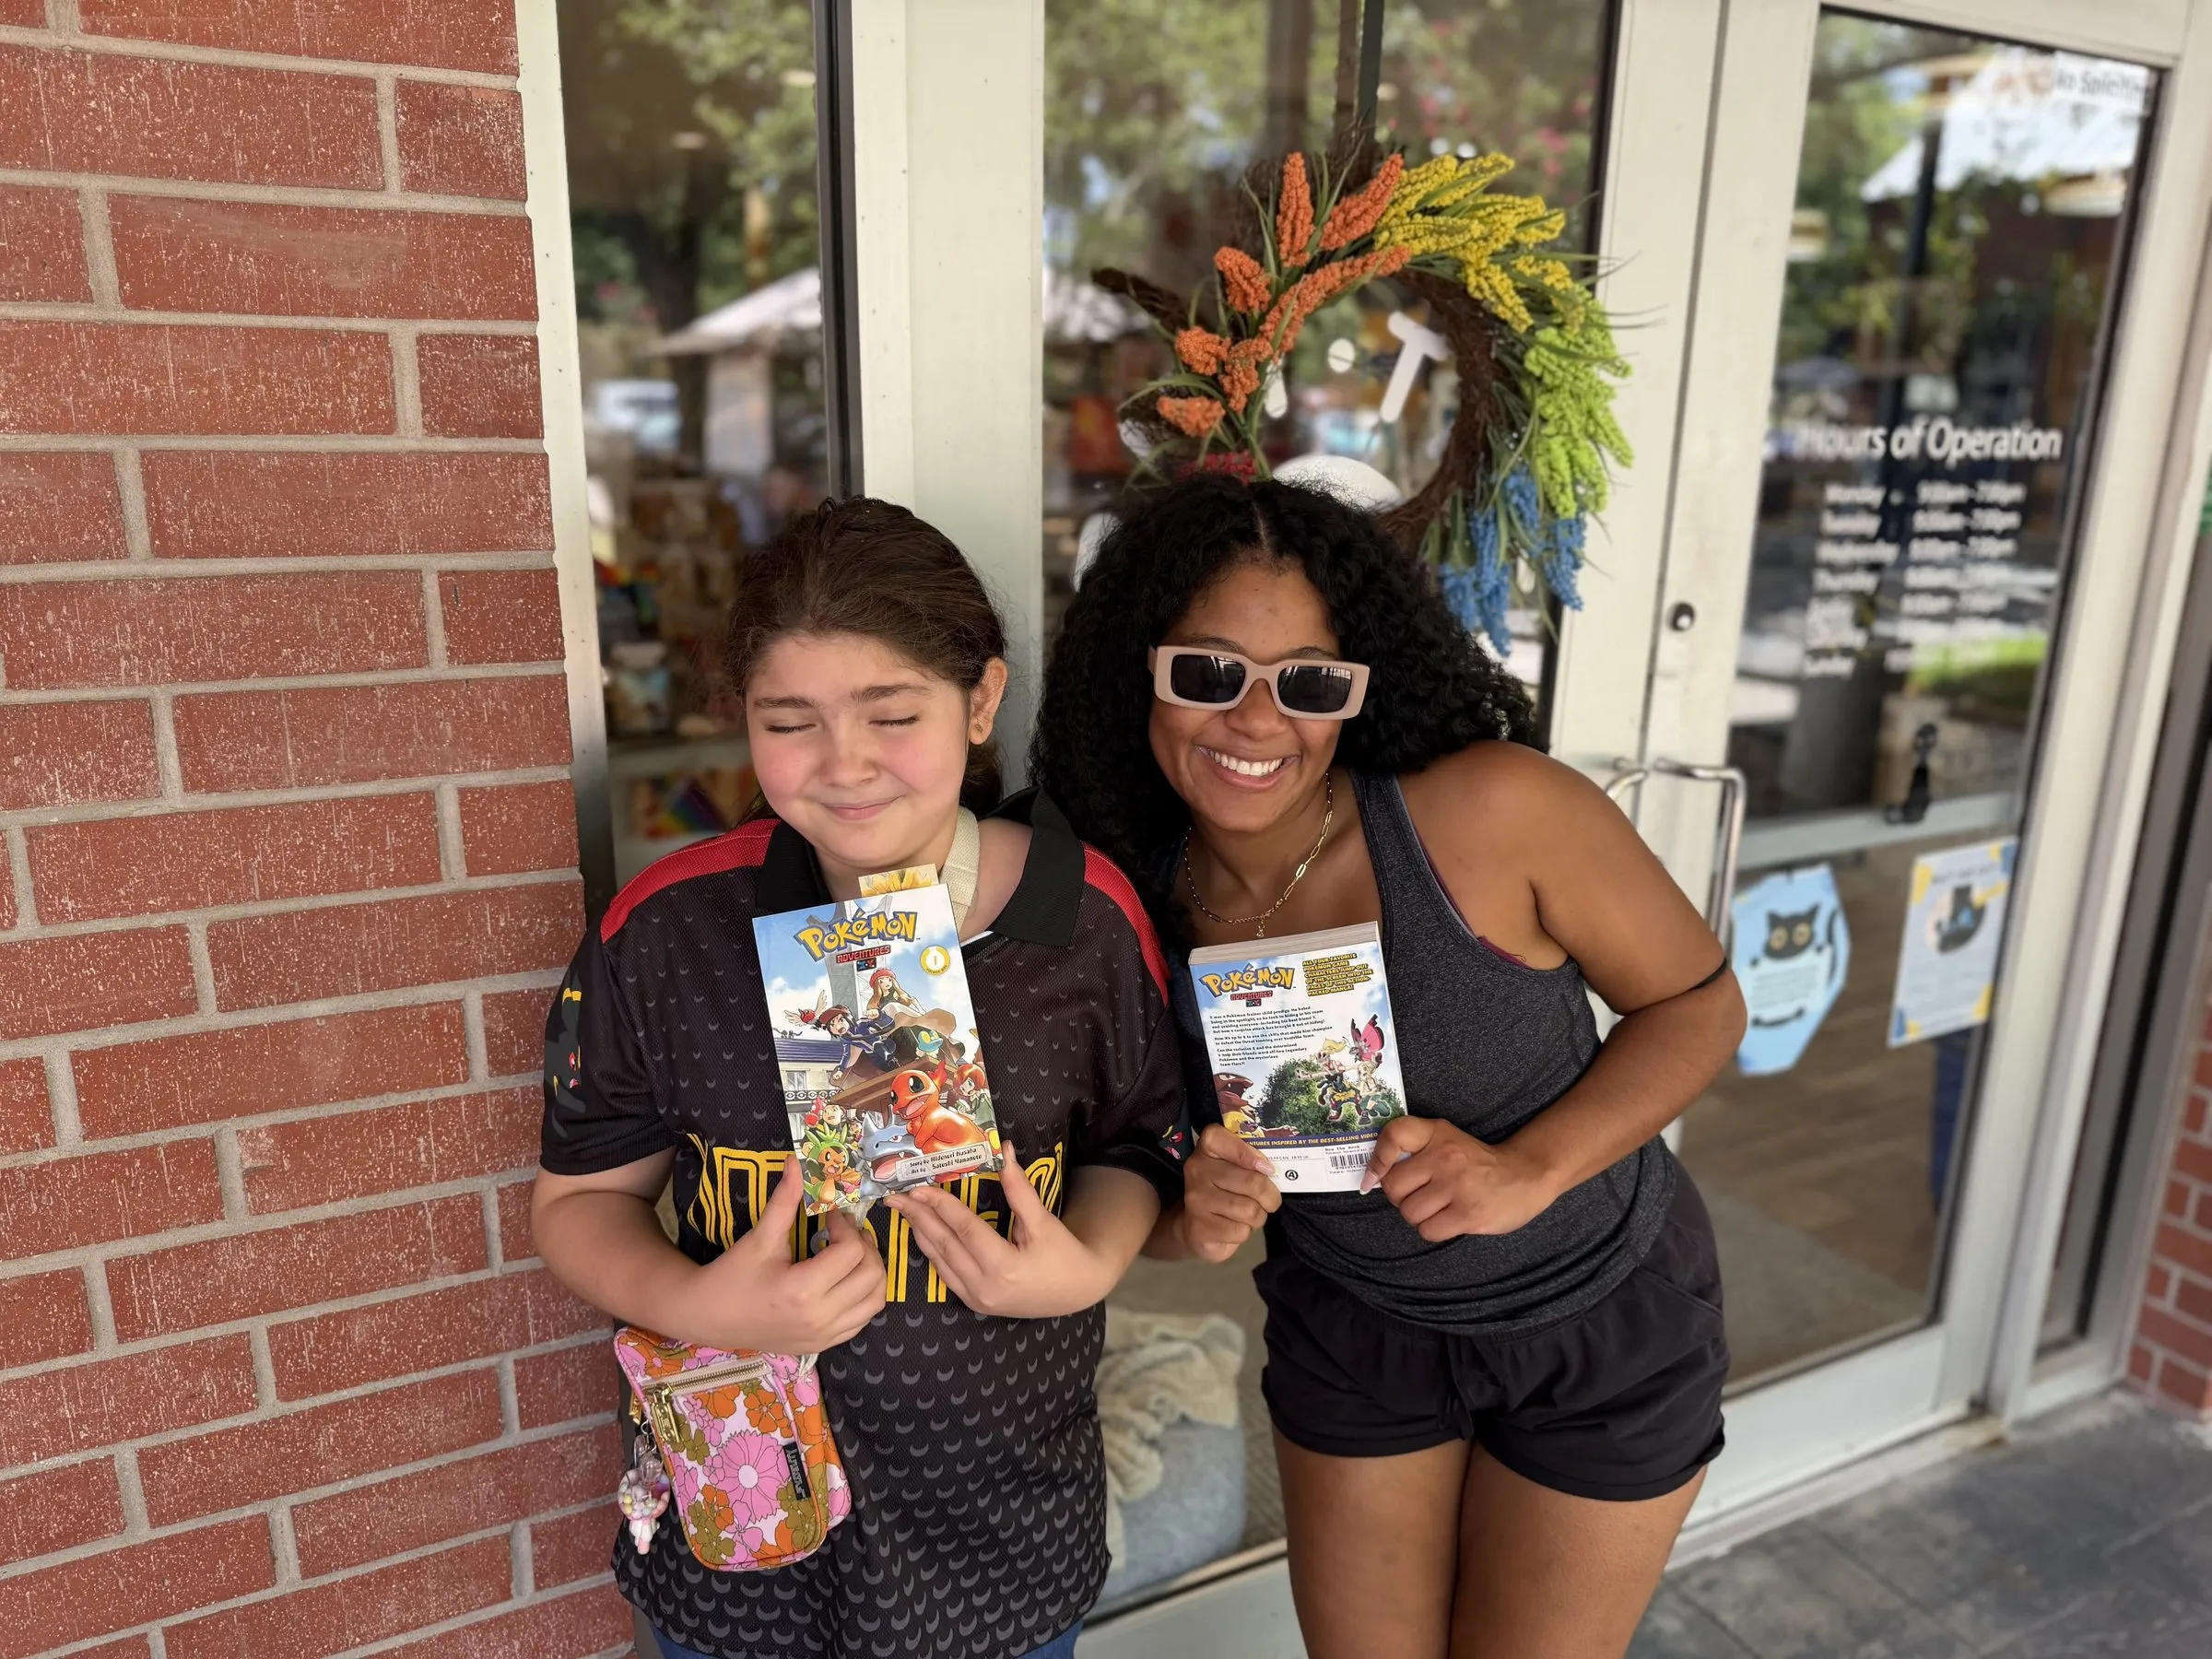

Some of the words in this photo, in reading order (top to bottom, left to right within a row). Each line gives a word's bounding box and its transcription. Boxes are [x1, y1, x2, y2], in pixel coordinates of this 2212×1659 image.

[1800, 425, 1887, 461] Hours
[1891, 417, 1926, 460] of
[1926, 417, 2062, 469] Operation
[837, 946, 890, 963] ADVENTURES
[1330, 954, 1357, 962] FAVORITE
[933, 955, 937, 966] 1
[1305, 969, 1339, 978] CHARACTERS
[1230, 990, 1273, 1001] ADVENTURES
[1320, 1135, 1359, 1144] BEST-SELLING
[1360, 1132, 1379, 1140] VIDEO
[910, 1159, 923, 1168] Story
[932, 1159, 954, 1170] Satoshi
